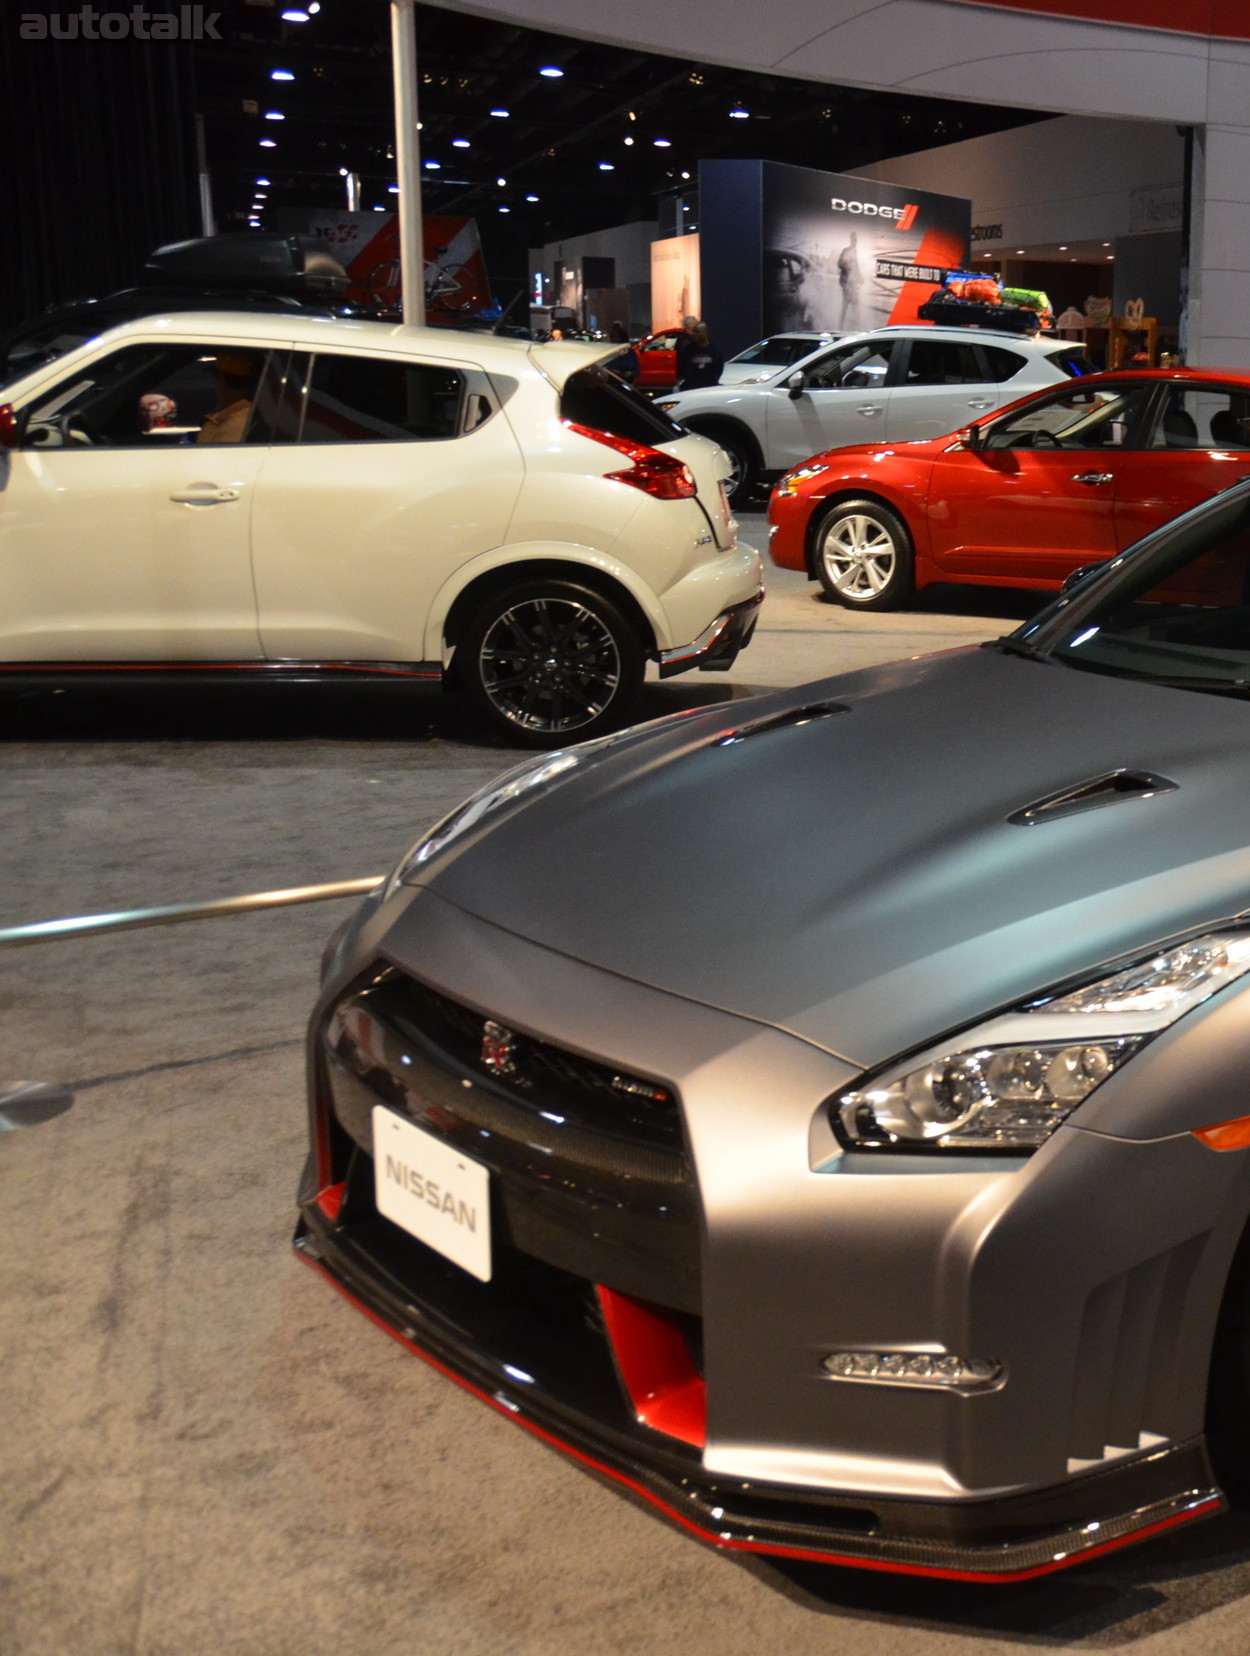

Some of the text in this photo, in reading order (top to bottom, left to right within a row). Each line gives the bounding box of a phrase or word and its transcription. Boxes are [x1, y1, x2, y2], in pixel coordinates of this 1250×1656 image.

[831, 198, 907, 220] DODGE
[904, 266, 919, 279] WERE
[385, 1154, 477, 1234] NISSAN
